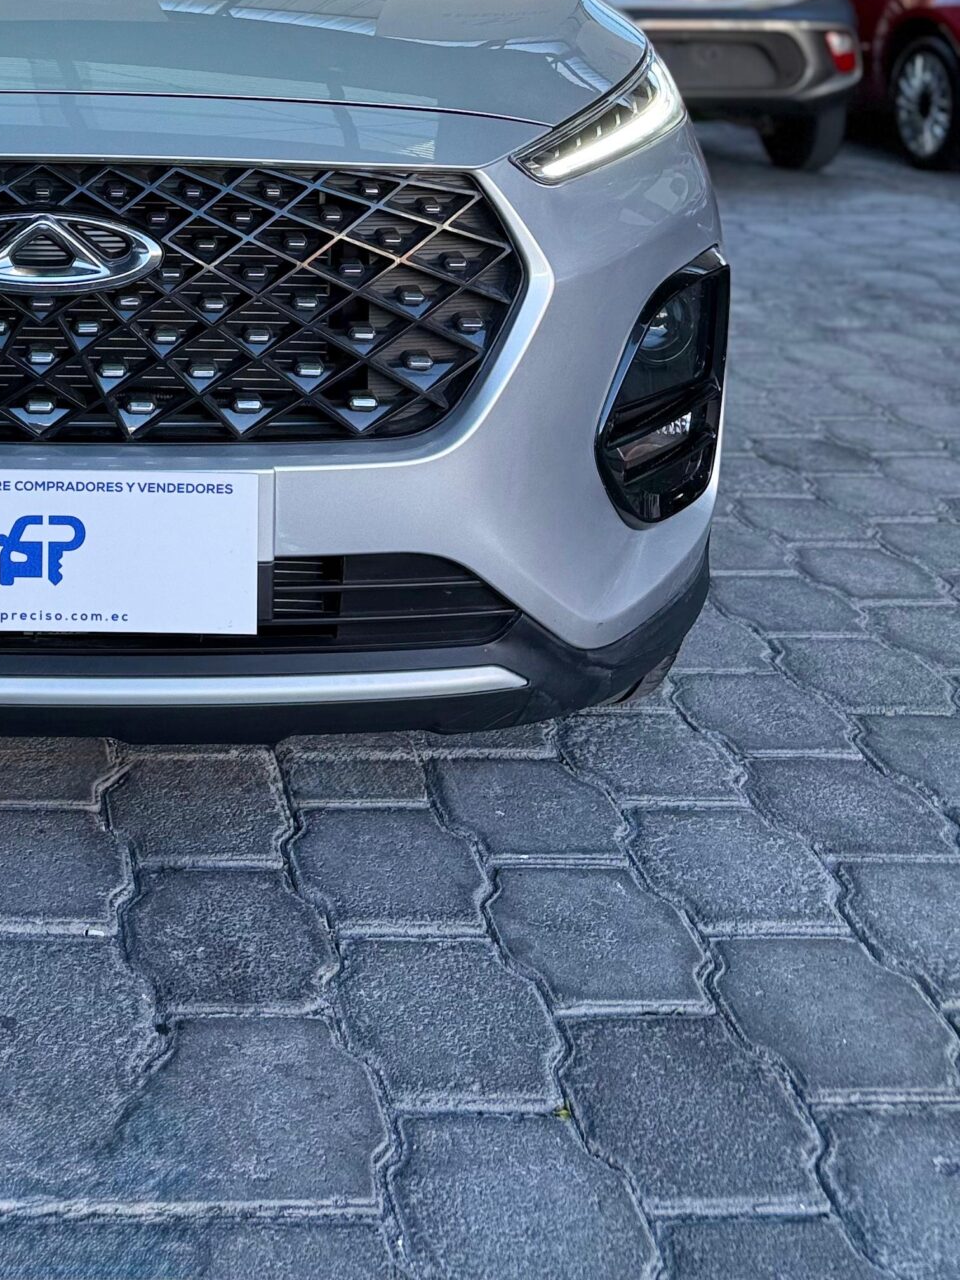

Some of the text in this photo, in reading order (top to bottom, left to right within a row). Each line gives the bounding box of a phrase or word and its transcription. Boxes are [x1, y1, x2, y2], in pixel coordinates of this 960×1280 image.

[14, 480, 124, 493] COMPRADORES
[125, 482, 136, 493] Y
[137, 482, 234, 495] VENDEDORES
